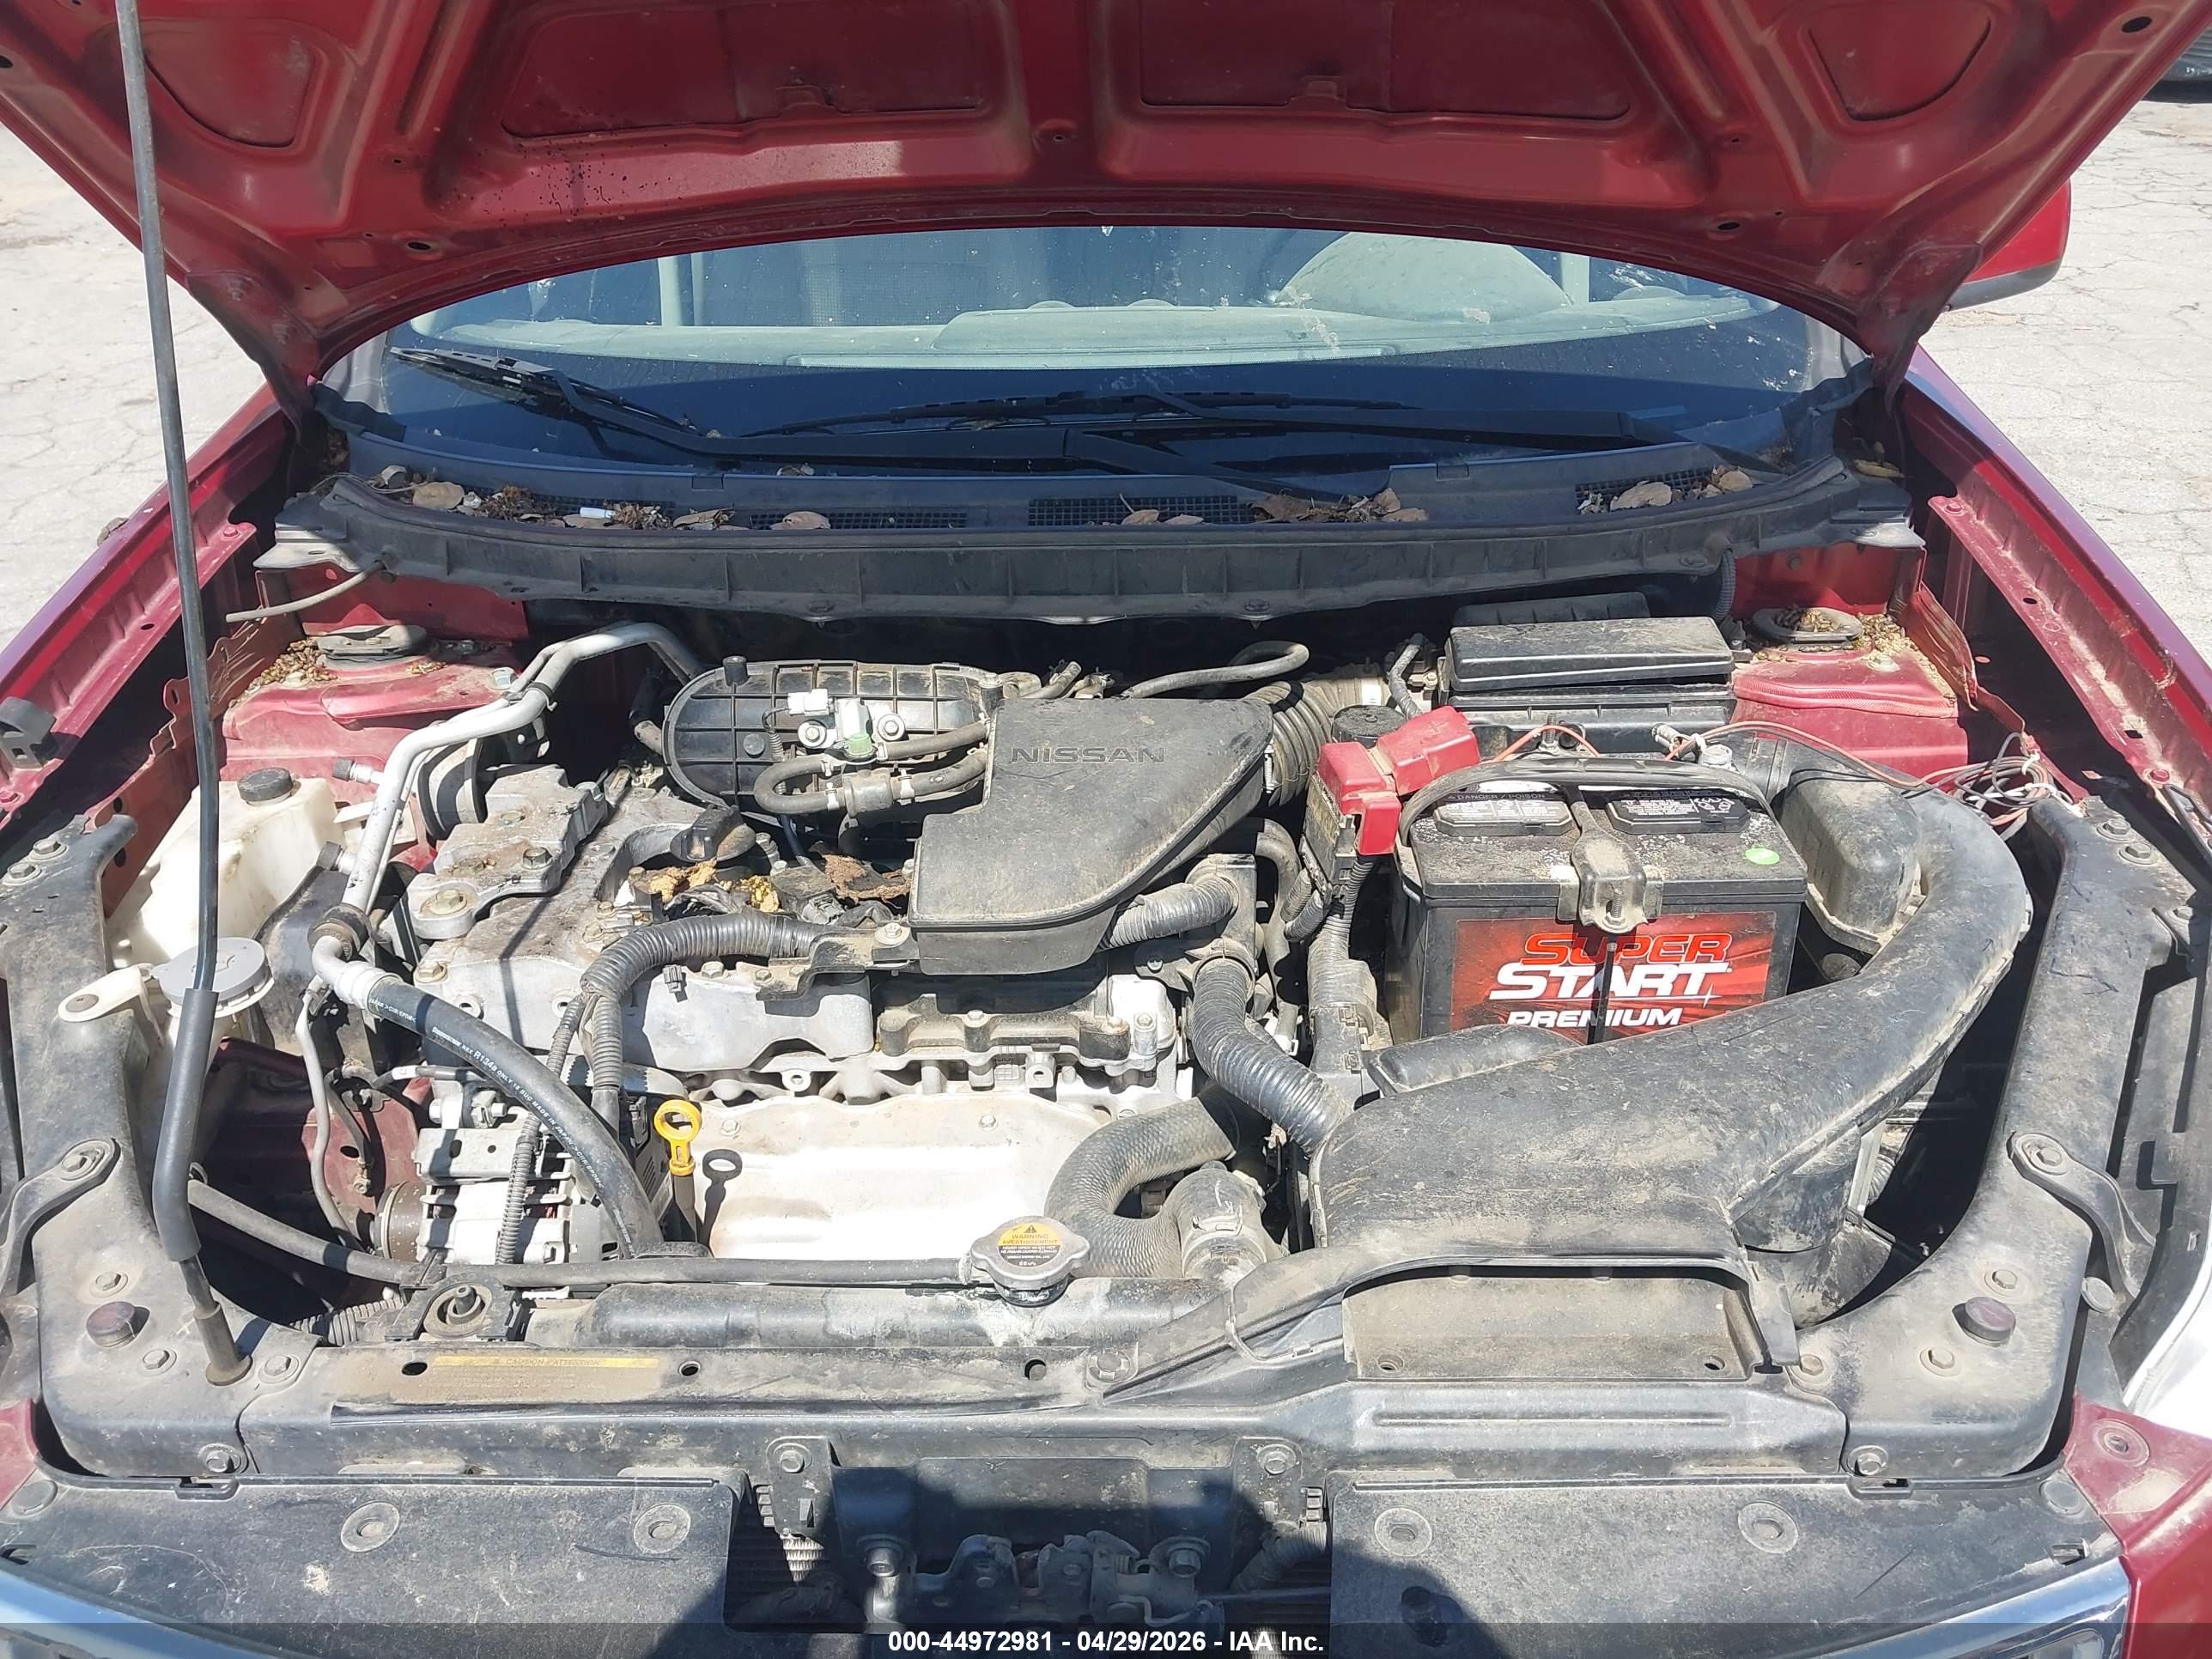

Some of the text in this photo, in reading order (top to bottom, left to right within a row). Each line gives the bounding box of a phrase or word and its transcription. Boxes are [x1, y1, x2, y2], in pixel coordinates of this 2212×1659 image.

[1011, 747, 1165, 763] NISSAN
[1519, 933, 1733, 966] SUPER
[1489, 962, 1729, 1000] START
[1507, 1008, 1683, 1029] PREMIUM
[496, 1070, 514, 1084] ONLY
[532, 1100, 550, 1118] MADE
[555, 1126, 574, 1146] JAPAN
